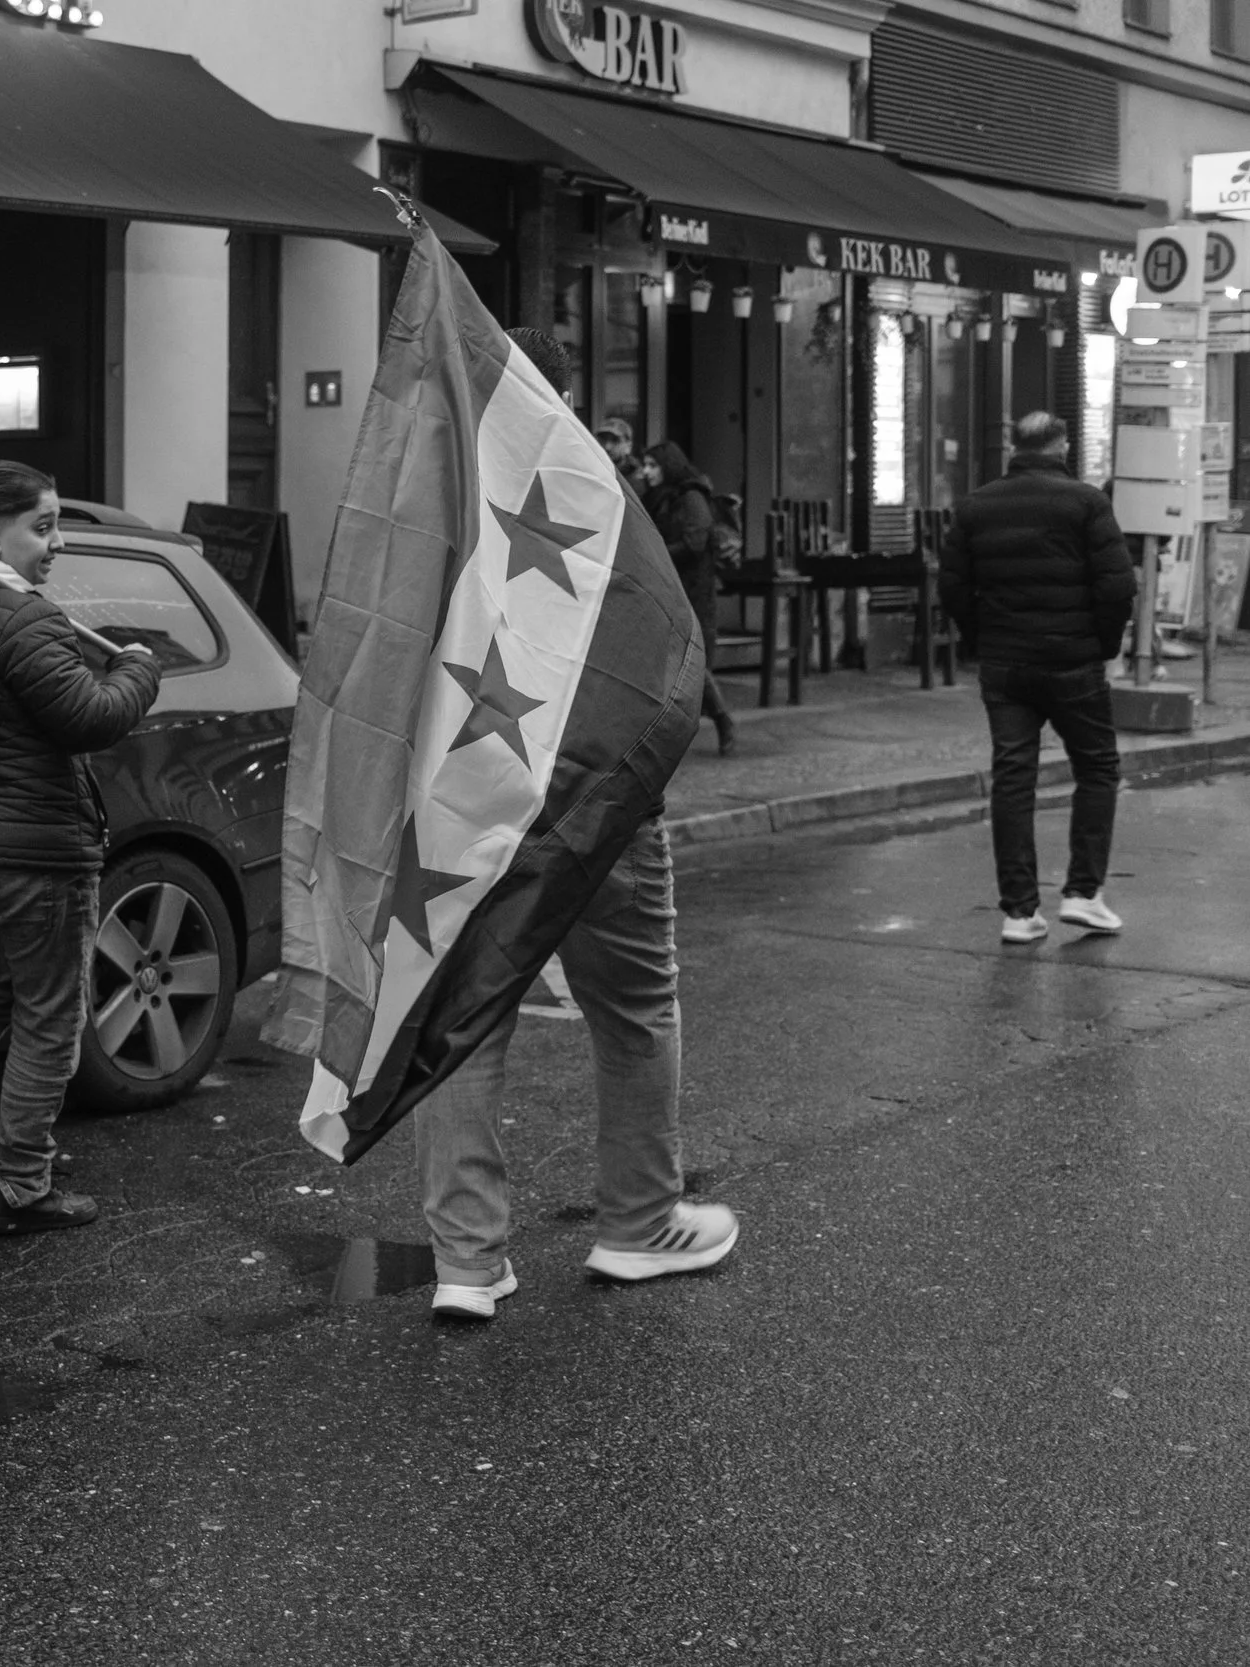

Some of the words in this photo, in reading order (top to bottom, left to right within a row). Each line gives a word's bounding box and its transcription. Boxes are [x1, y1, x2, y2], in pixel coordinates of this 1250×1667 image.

[602, 5, 689, 95] BAR
[839, 237, 885, 274] KEK
[889, 244, 932, 280] BAR
[1153, 250, 1172, 281] H
